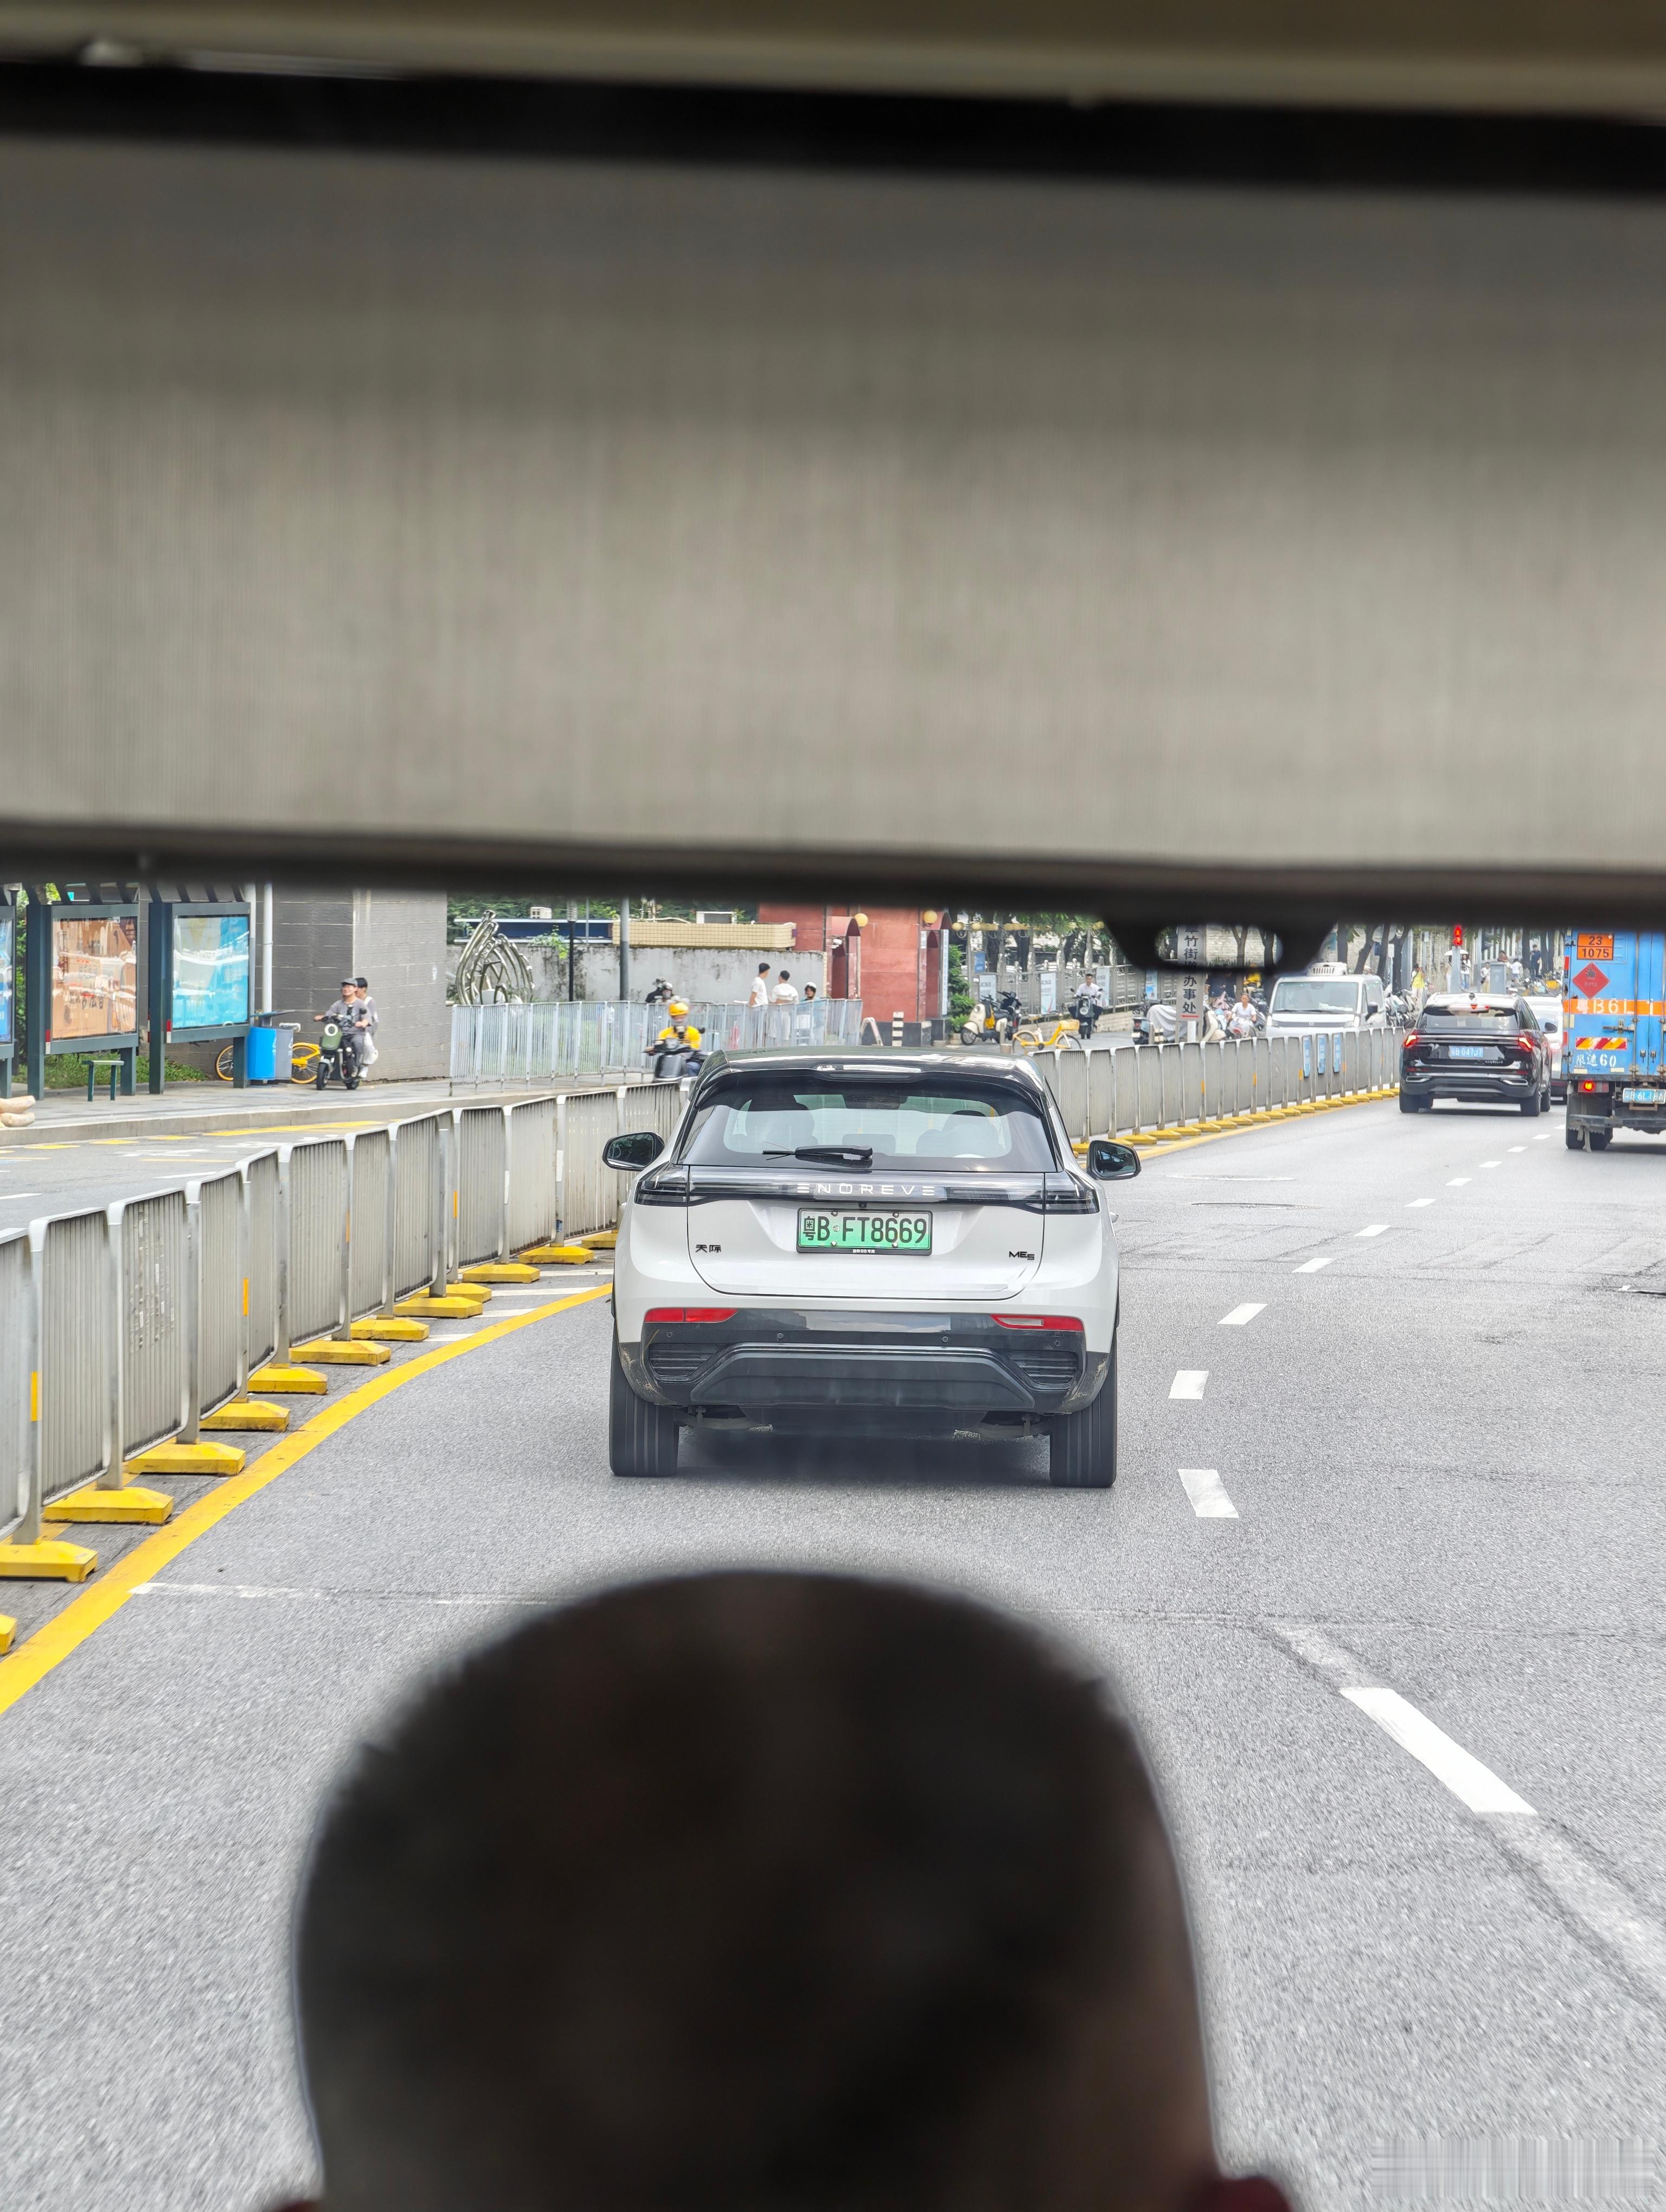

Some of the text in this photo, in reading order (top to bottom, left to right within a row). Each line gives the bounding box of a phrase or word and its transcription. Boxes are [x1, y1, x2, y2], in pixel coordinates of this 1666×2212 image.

[1588, 936, 1603, 946] 23
[1582, 948, 1610, 958] 1075
[1183, 927, 1199, 1014] 竹街办事处
[797, 1183, 935, 1196] ENOREVE
[695, 1244, 722, 1253] 天际
